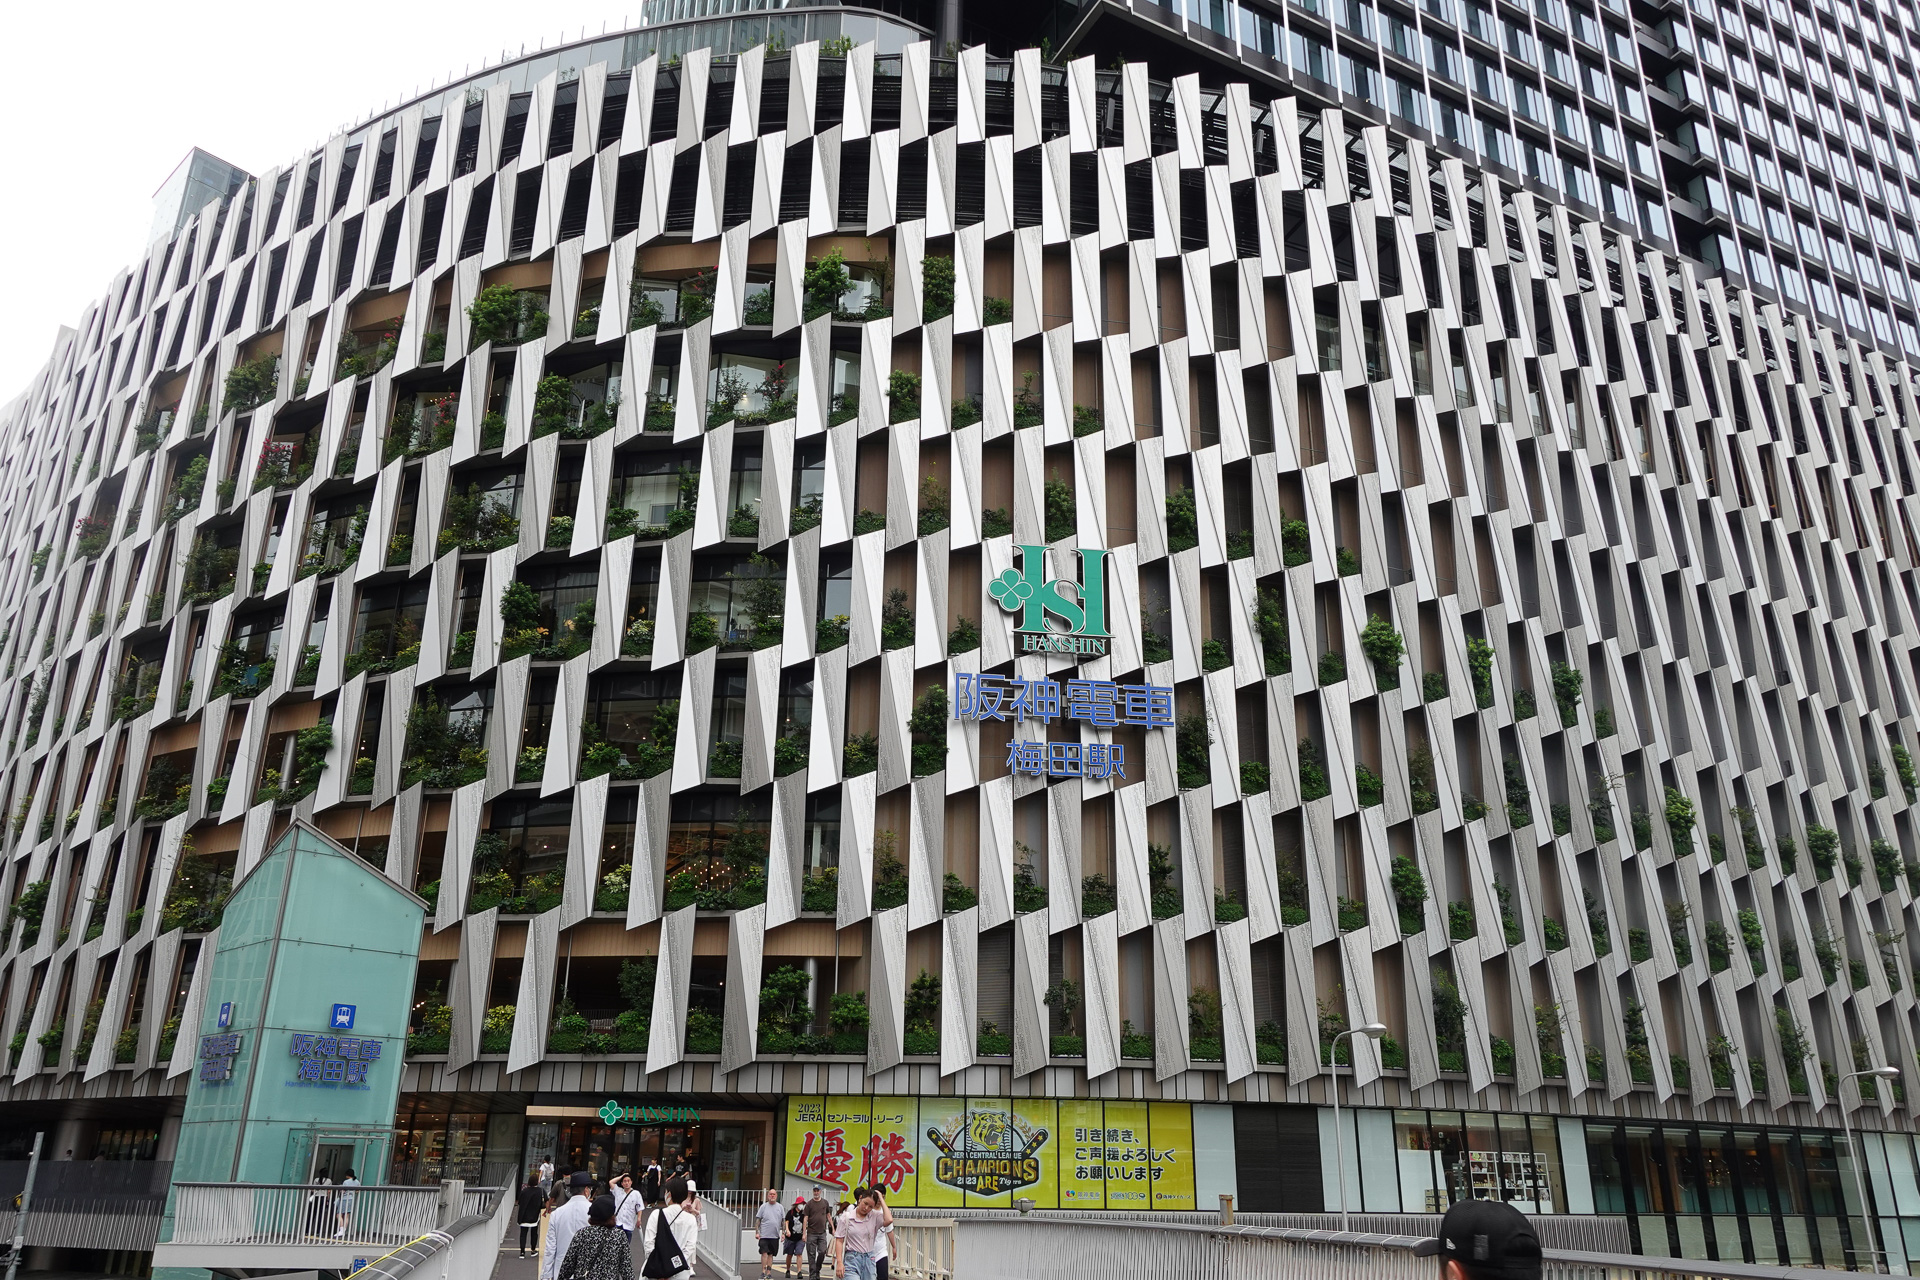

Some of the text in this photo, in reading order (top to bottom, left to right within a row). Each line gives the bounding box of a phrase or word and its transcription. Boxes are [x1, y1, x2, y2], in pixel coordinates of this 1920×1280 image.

[1022, 634, 1106, 655] HANSHIN
[954, 672, 1175, 729] 阪神電車
[1006, 738, 1126, 780] 梅田駅
[290, 1033, 383, 1061] 阪神電車
[298, 1058, 369, 1083] 梅田駅
[624, 1105, 701, 1122] HANSHIN
[798, 1103, 821, 1113] 2023
[794, 1113, 823, 1122] JERA
[1075, 1128, 1140, 1144] 引き続き、
[794, 1127, 915, 1193] 優勝
[969, 1151, 997, 1159] CENTRAL
[1075, 1147, 1176, 1163] ご声援よろしく
[939, 1158, 1037, 1182] CHAMPIONS
[1075, 1166, 1164, 1181] お願いします
[976, 1176, 1000, 1192] ARE
